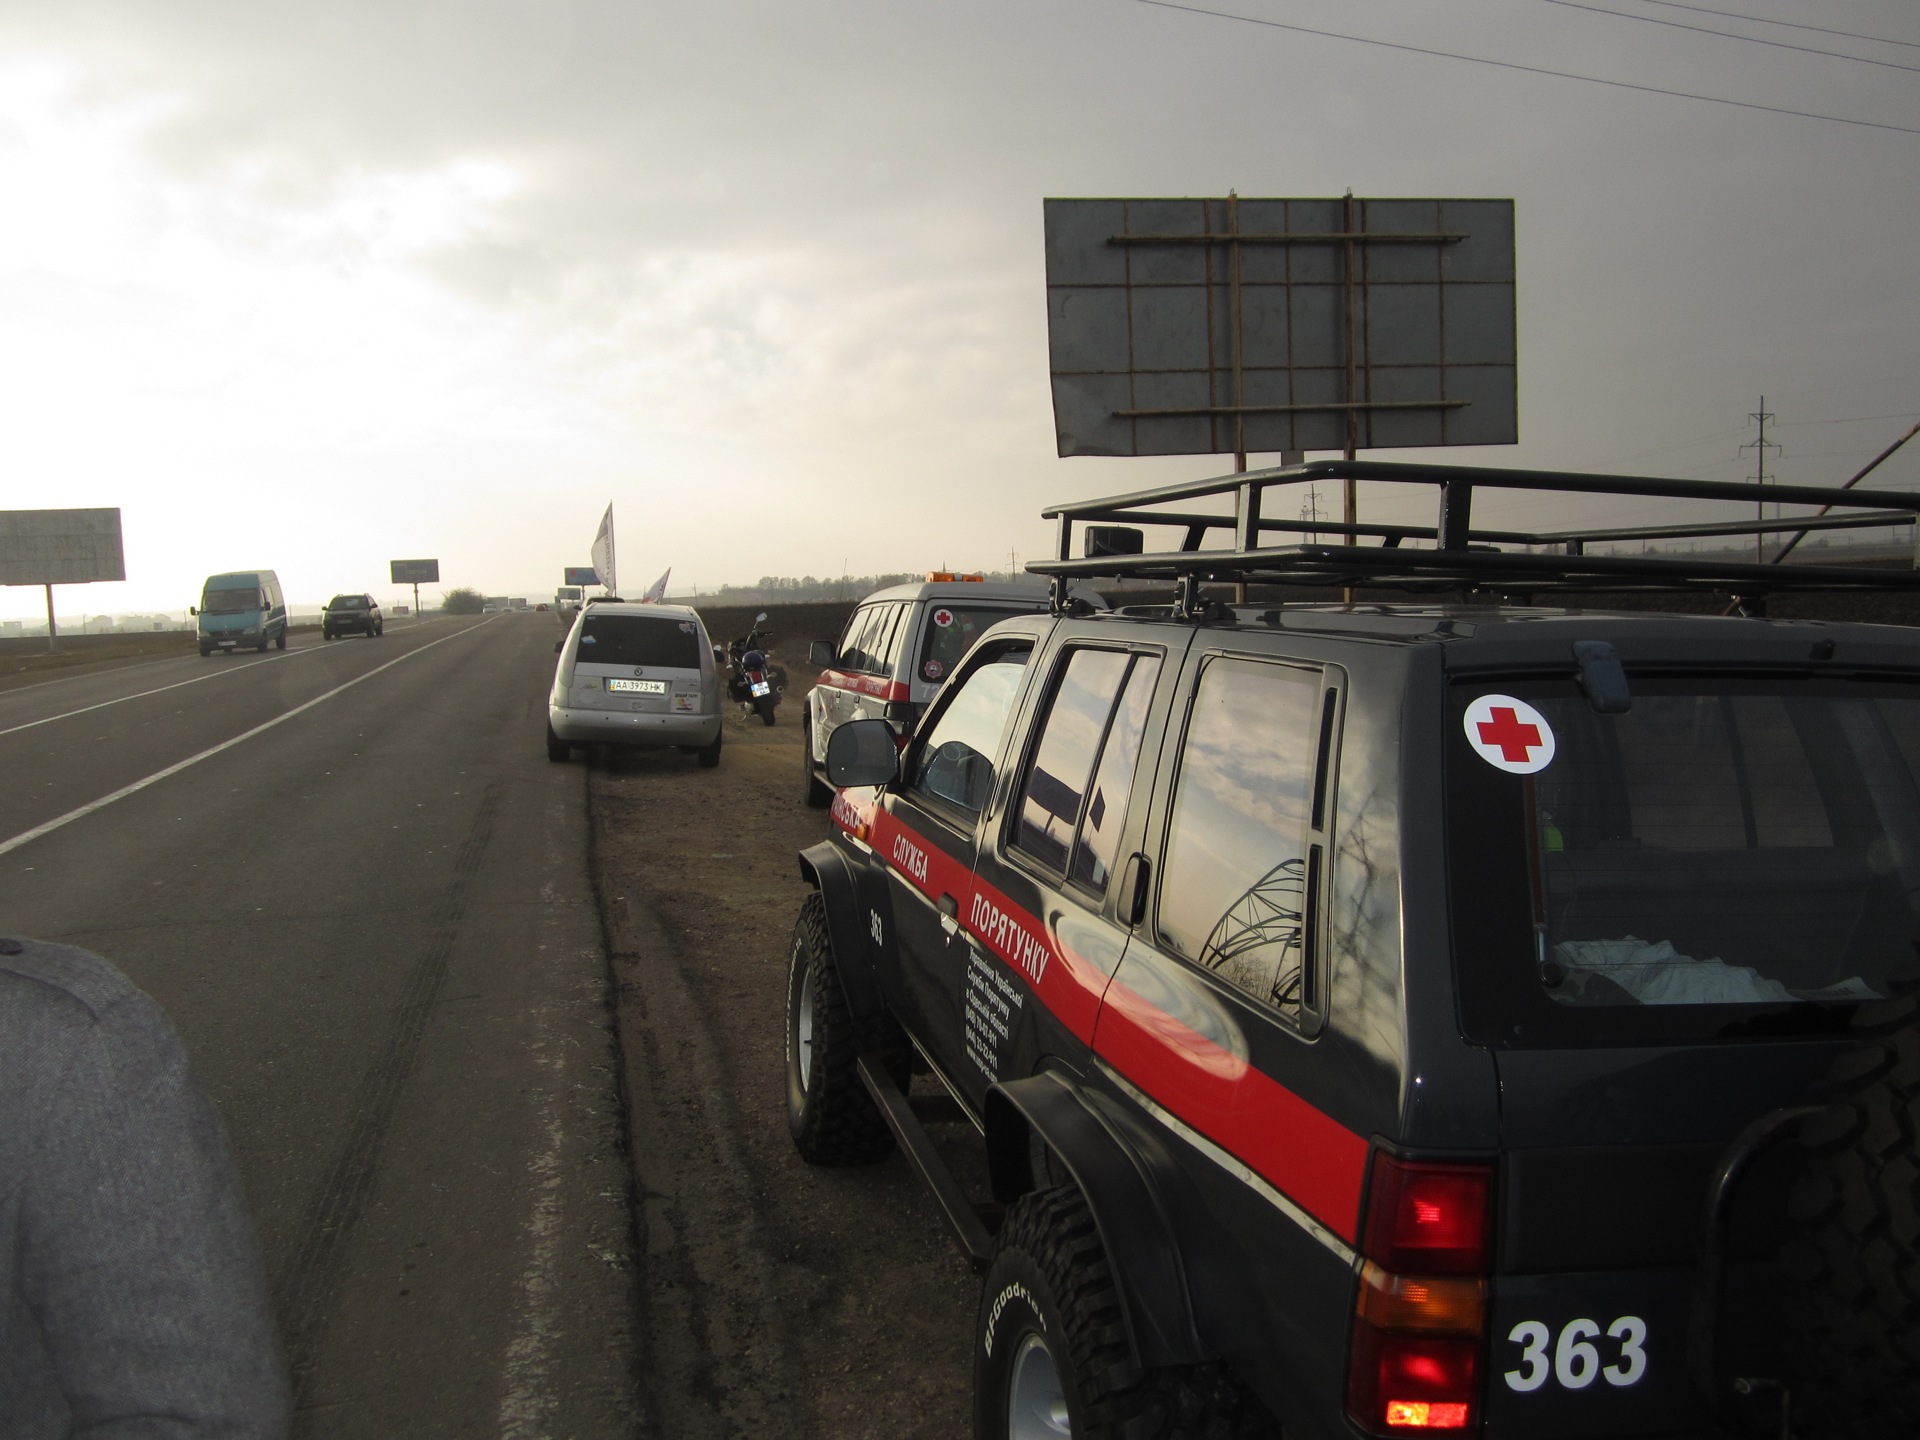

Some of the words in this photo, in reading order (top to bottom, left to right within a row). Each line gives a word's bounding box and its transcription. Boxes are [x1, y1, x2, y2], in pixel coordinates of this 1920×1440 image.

[615, 681, 628, 690] AA
[629, 681, 649, 691] 3973
[870, 908, 883, 947] 363
[893, 833, 928, 884] СЛУЖБА
[970, 892, 1050, 985] ПОРЯТУНКУ
[984, 981, 1010, 1021] Порятунку
[984, 1281, 1047, 1359] BFGoodrich
[1504, 1315, 1647, 1392] 363
